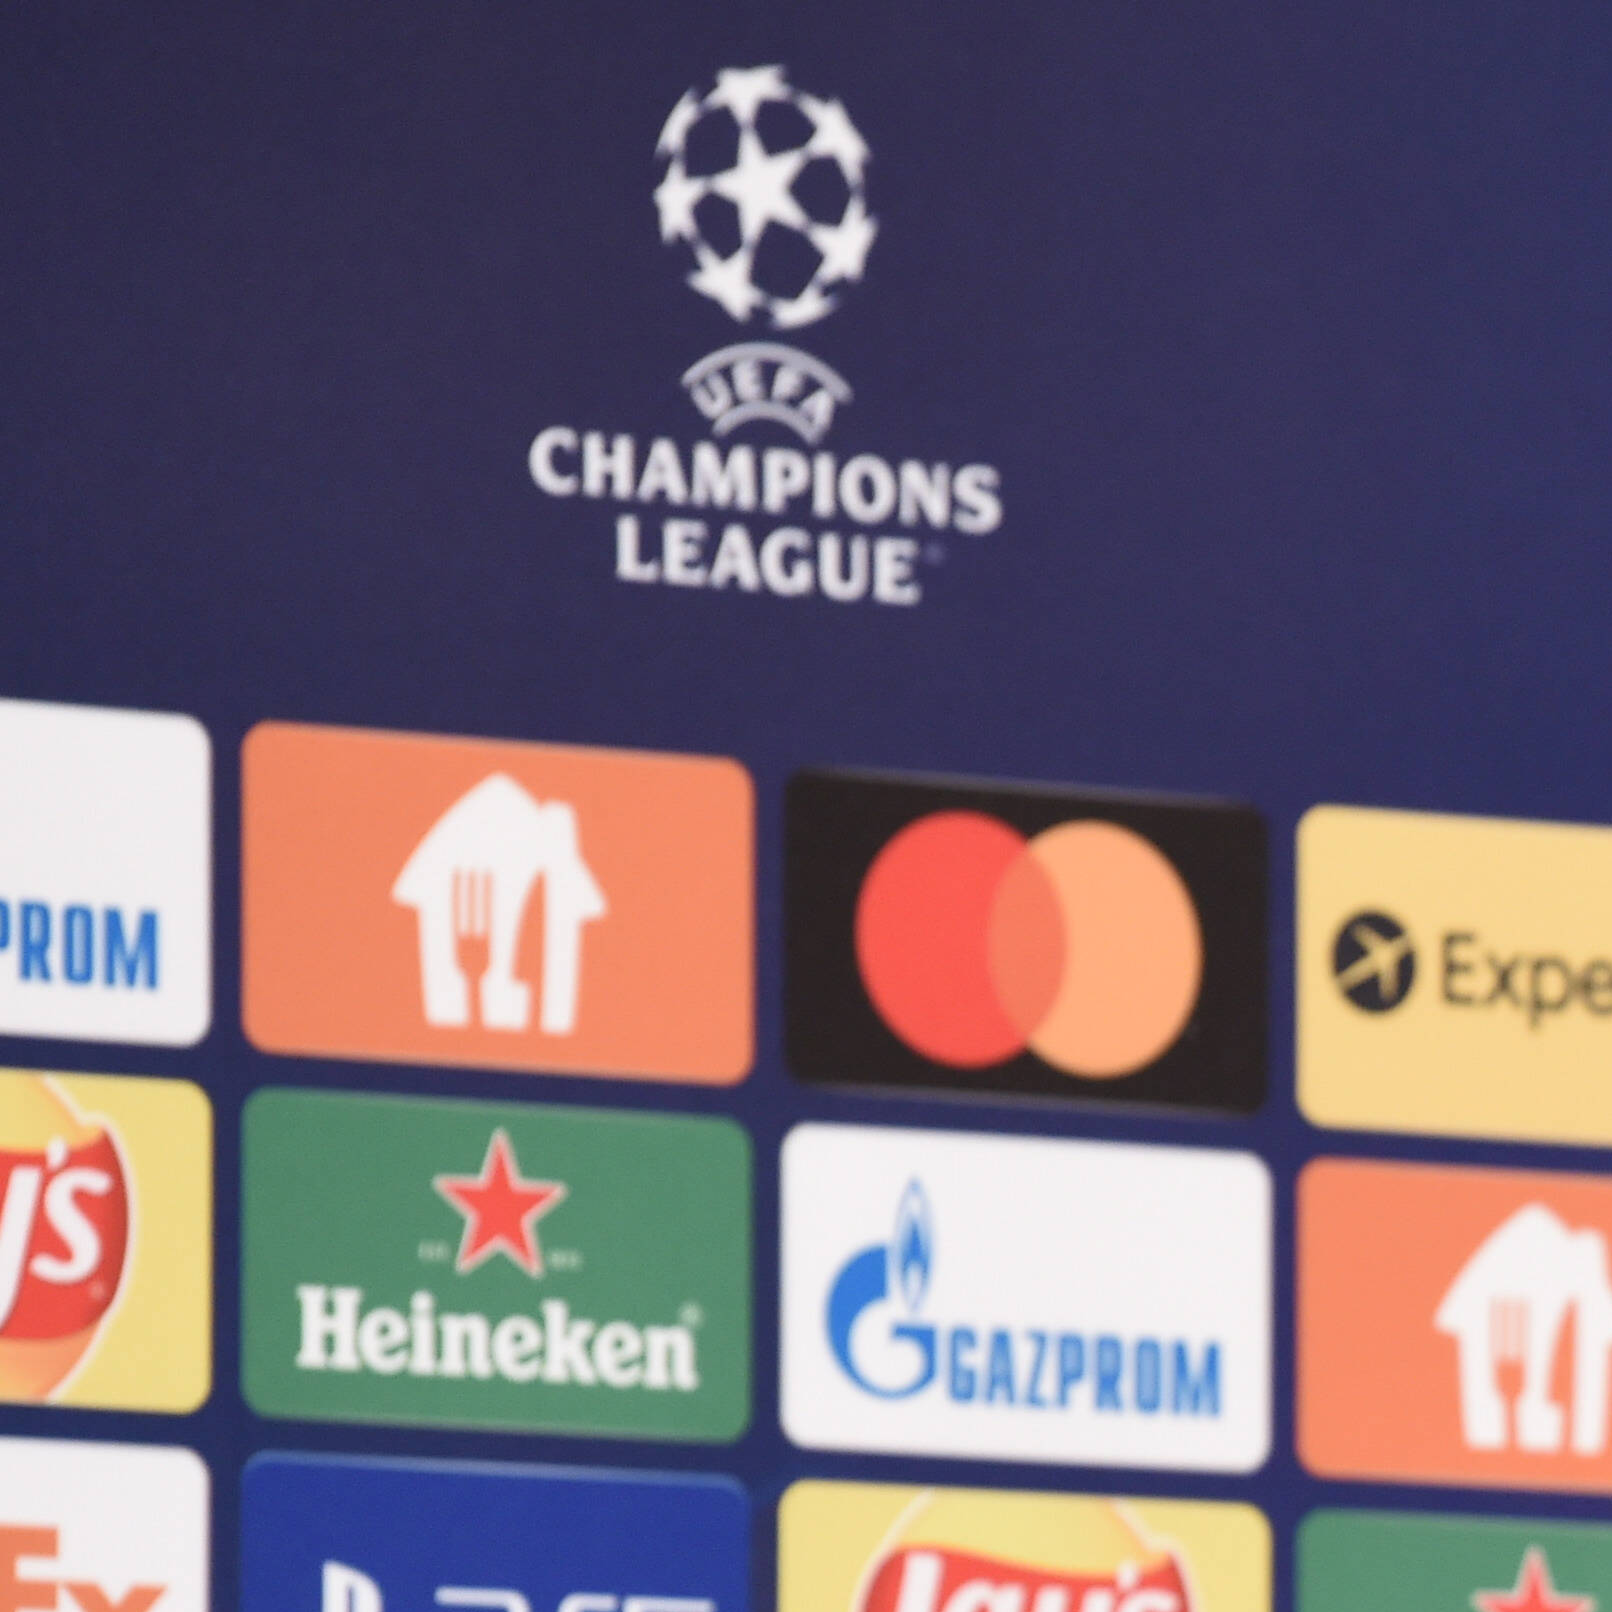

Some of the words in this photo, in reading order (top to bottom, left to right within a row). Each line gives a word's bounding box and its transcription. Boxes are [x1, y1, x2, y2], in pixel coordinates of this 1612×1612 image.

[529, 427, 1001, 535] CHAMPIONS
[615, 515, 921, 606] LEAGUE
[296, 1284, 699, 1392] Heineken
[948, 1325, 1223, 1418] GAZPROM
